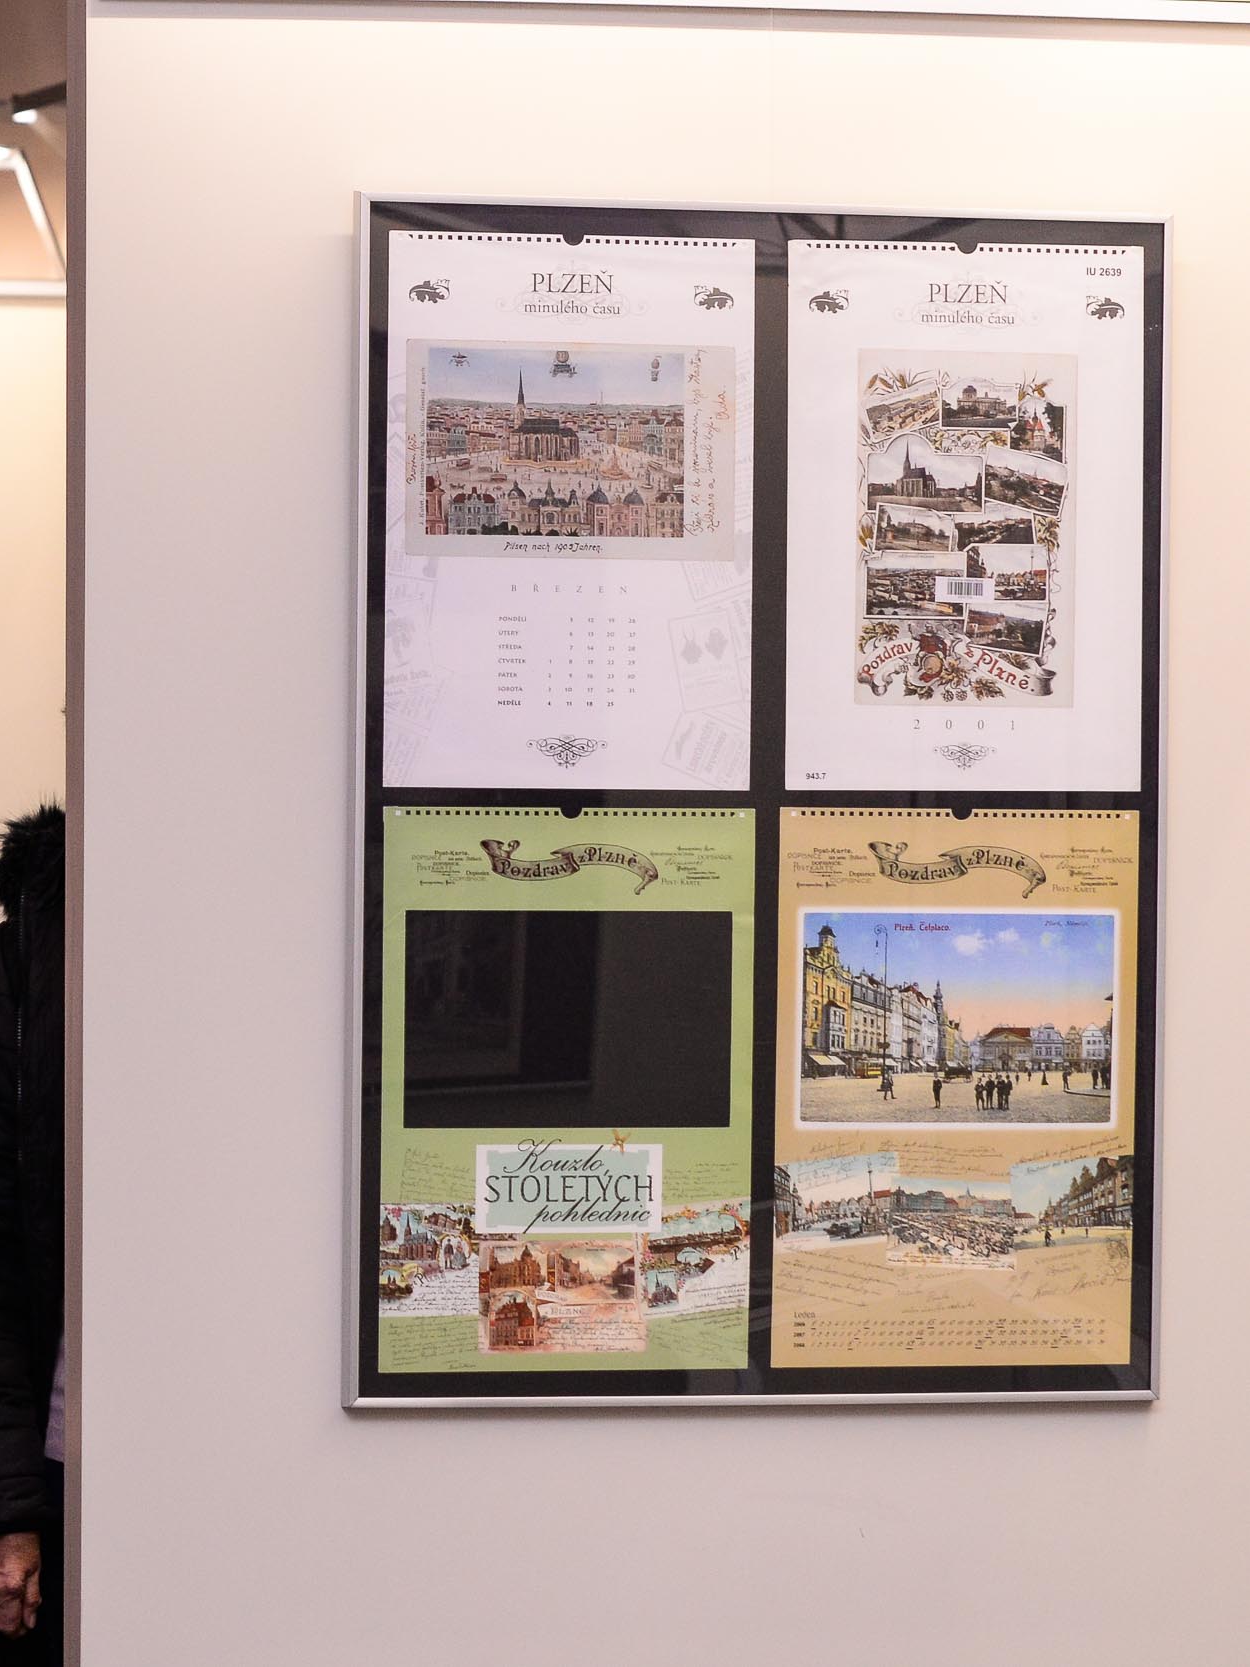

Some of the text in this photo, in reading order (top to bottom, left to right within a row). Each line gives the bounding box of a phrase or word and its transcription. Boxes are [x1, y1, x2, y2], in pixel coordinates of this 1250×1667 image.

[531, 270, 614, 294] PLZEŇ
[1086, 267, 1122, 277] IU 2639
[928, 281, 1009, 304] PLZEŇ
[524, 299, 621, 315] minulého času
[921, 310, 1015, 325] minulého času
[859, 641, 914, 677] Pozdrav
[805, 772, 827, 780] 943.7
[500, 858, 569, 879] Pozdrav
[584, 846, 638, 868] Plzně
[888, 861, 957, 881] Pozdrav
[973, 849, 1026, 871] Plzně
[503, 1138, 604, 1173] Kouzlo
[484, 1169, 654, 1203] STOLETÝCH
[522, 1196, 652, 1234] pohlednic
